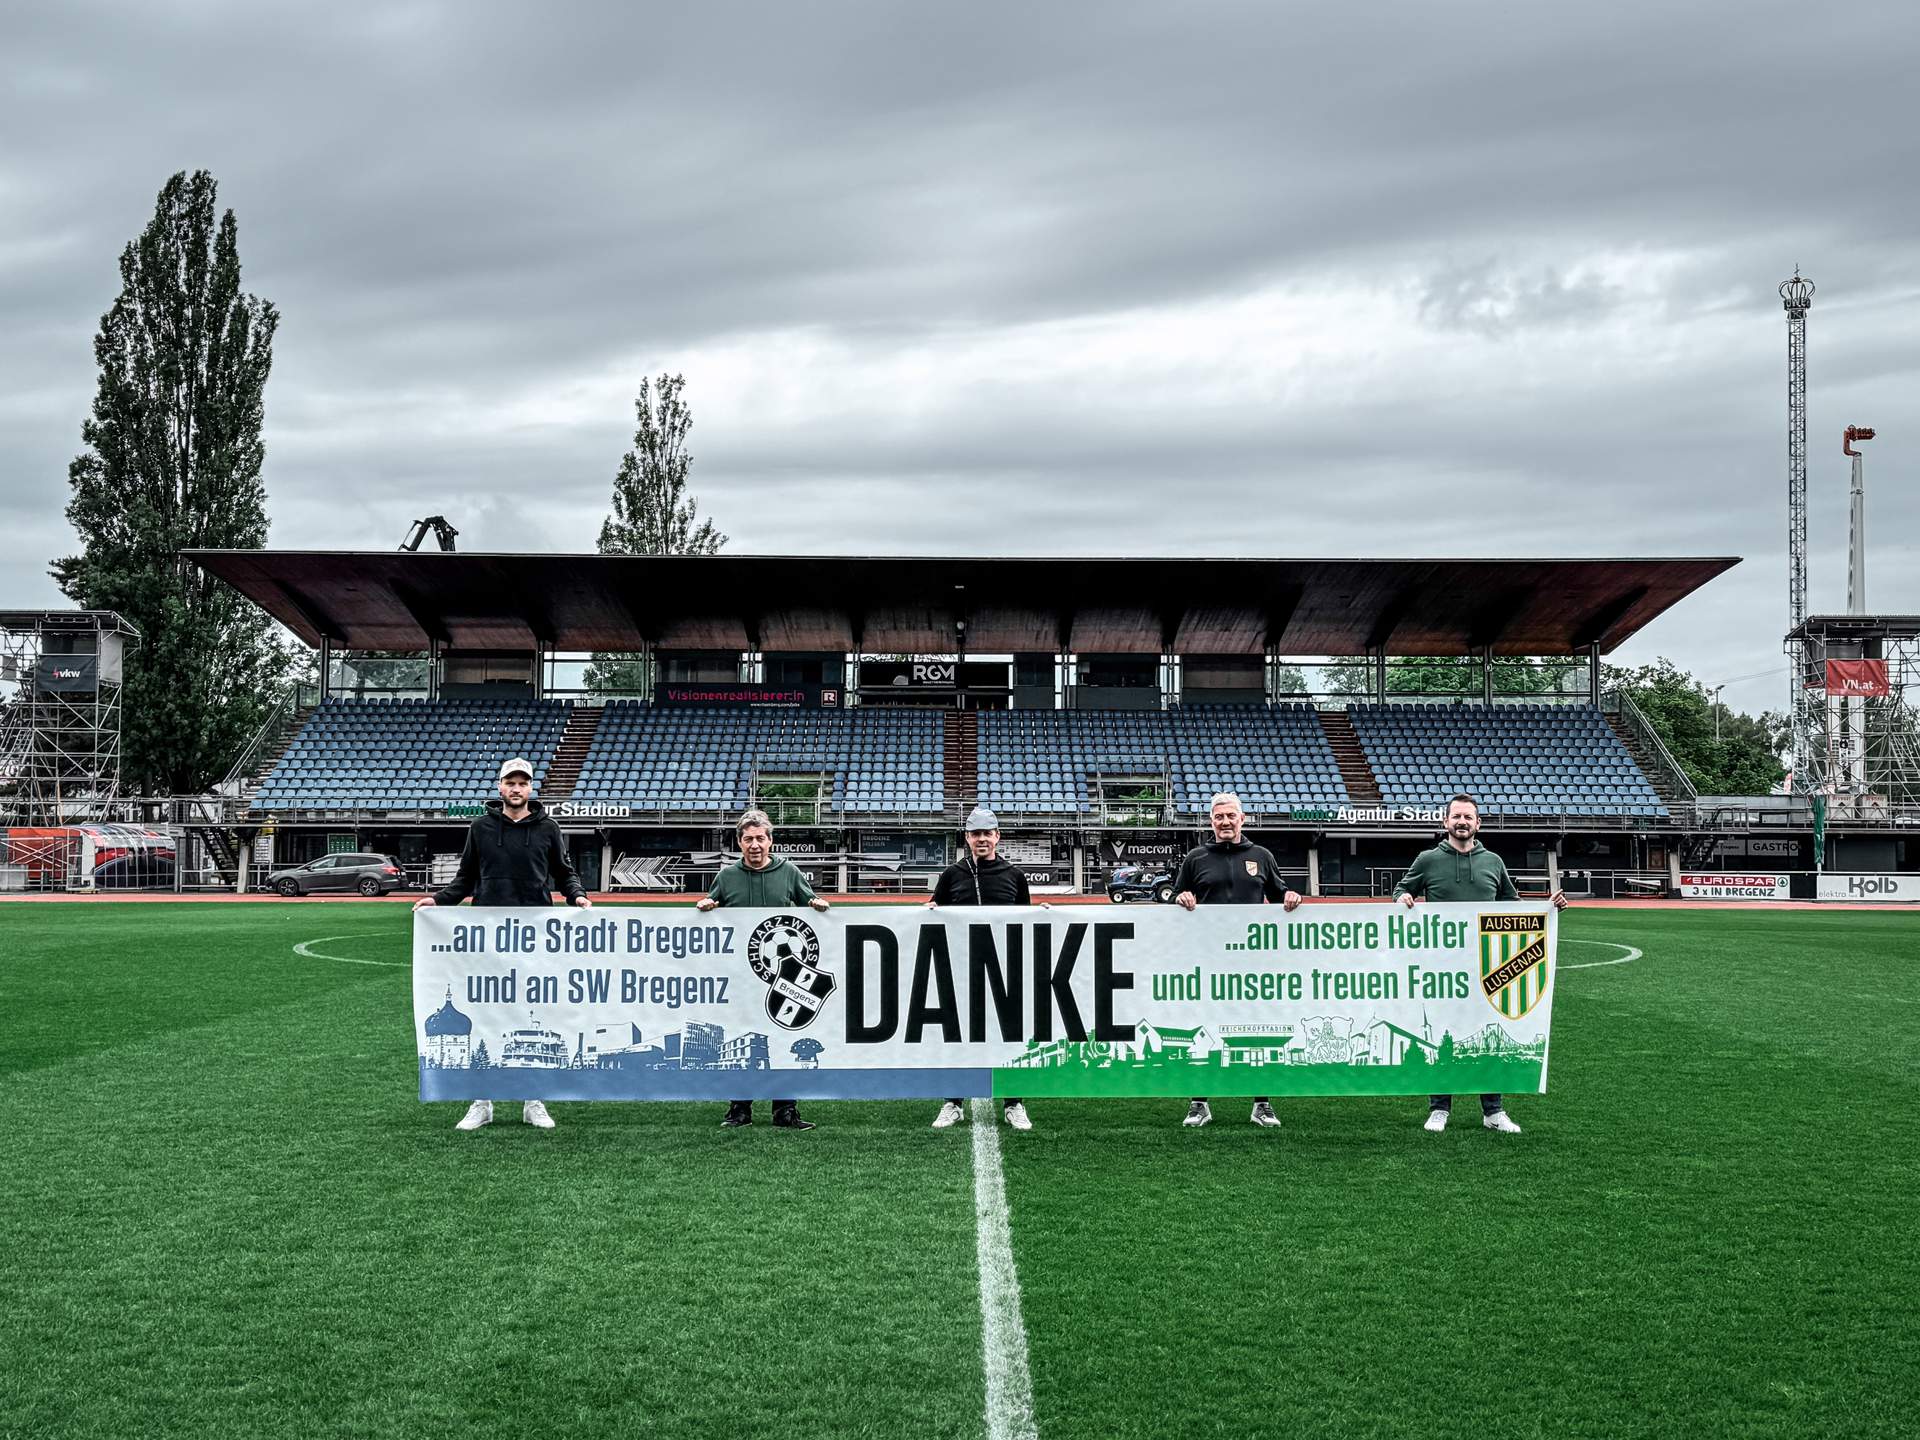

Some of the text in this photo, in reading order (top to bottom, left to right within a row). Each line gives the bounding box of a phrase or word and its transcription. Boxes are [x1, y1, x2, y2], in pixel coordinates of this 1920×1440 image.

[60, 669, 80, 678] vkw
[913, 664, 955, 680] RGM
[1842, 679, 1874, 690] VN.at
[560, 801, 630, 817] Stadion
[1337, 806, 1400, 824] Agentur
[1402, 805, 1447, 821] Stadi
[772, 843, 816, 853] macron
[1128, 844, 1173, 854] macron
[1752, 842, 1798, 851] GASTRO
[1024, 872, 1050, 882] cron
[1692, 877, 1775, 885] EUROSPAR
[1692, 887, 1700, 896] 3
[1711, 887, 1722, 896] IN
[1725, 887, 1775, 897] BREGENZ
[1819, 877, 1898, 898] elektro Kolb
[1485, 917, 1540, 929] AUSTRIA
[495, 918, 536, 953] die
[546, 918, 618, 953] Stadt
[627, 919, 735, 958] Bregenz
[1288, 921, 1378, 950] unsere
[1388, 914, 1468, 949] Helfer
[749, 916, 819, 981] SCHWARZ-WEISS
[1485, 944, 1544, 991] LUSTENAU
[467, 969, 729, 1008] und an SW Bregenz
[845, 922, 1136, 1043] DANKE
[1153, 965, 1469, 1000] und unsere treuen Fans
[779, 982, 817, 1007] Bregenz
